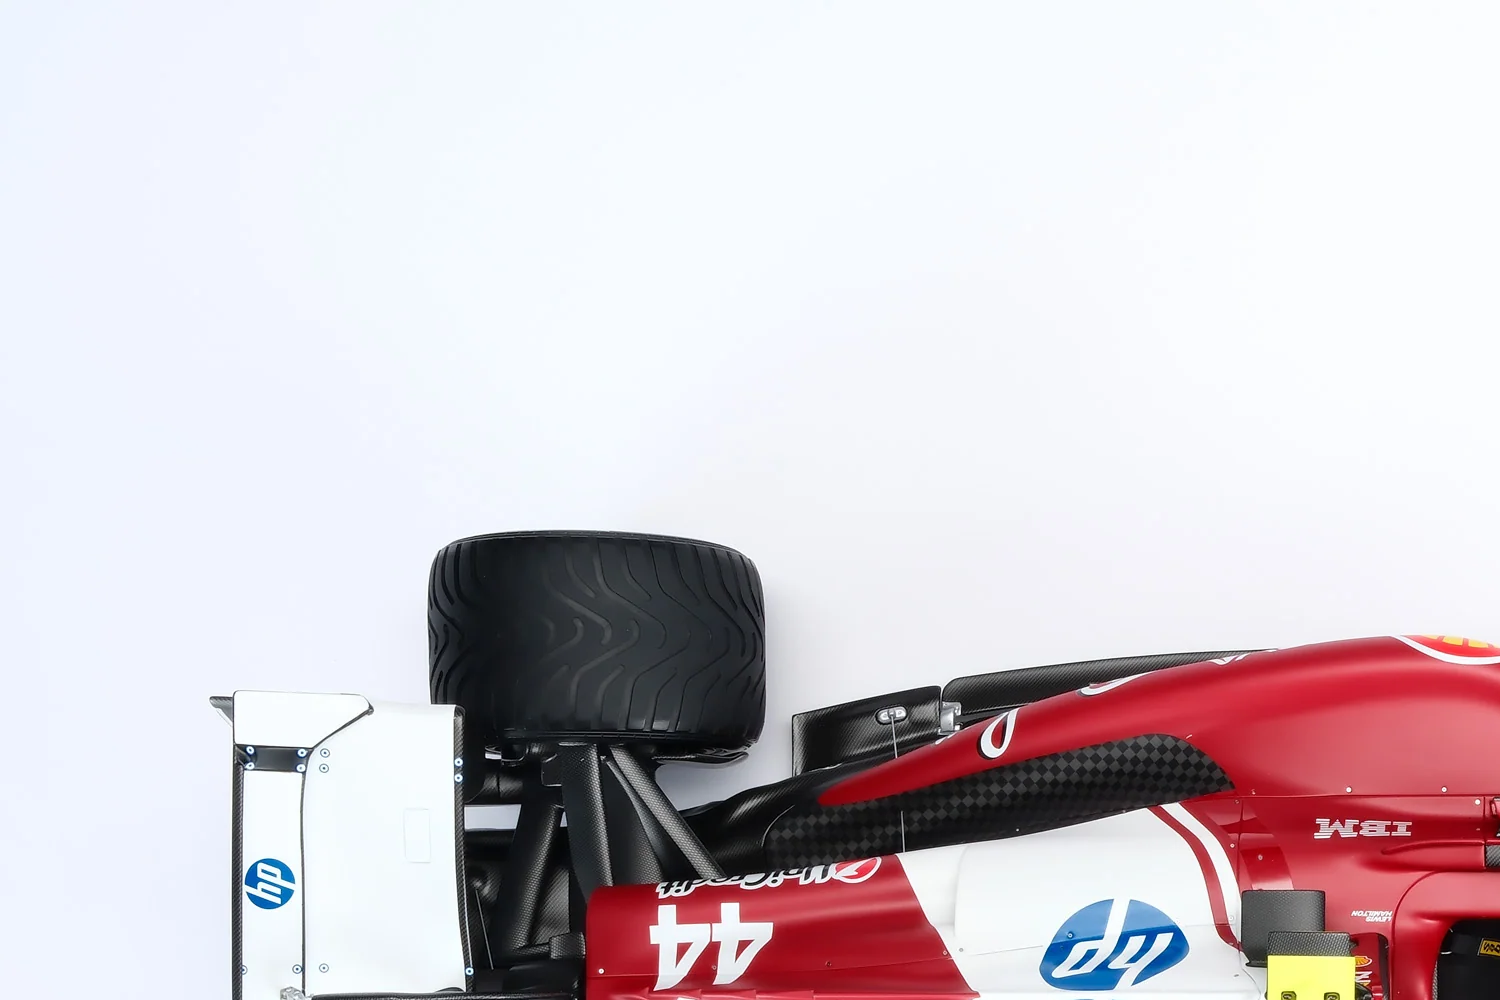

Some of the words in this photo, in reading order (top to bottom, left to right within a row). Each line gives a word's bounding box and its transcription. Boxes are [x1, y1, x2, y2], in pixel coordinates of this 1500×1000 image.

[1314, 818, 1412, 839] IBM
[245, 858, 295, 909] hp
[649, 902, 774, 991] 44
[1052, 899, 1174, 991] hp
